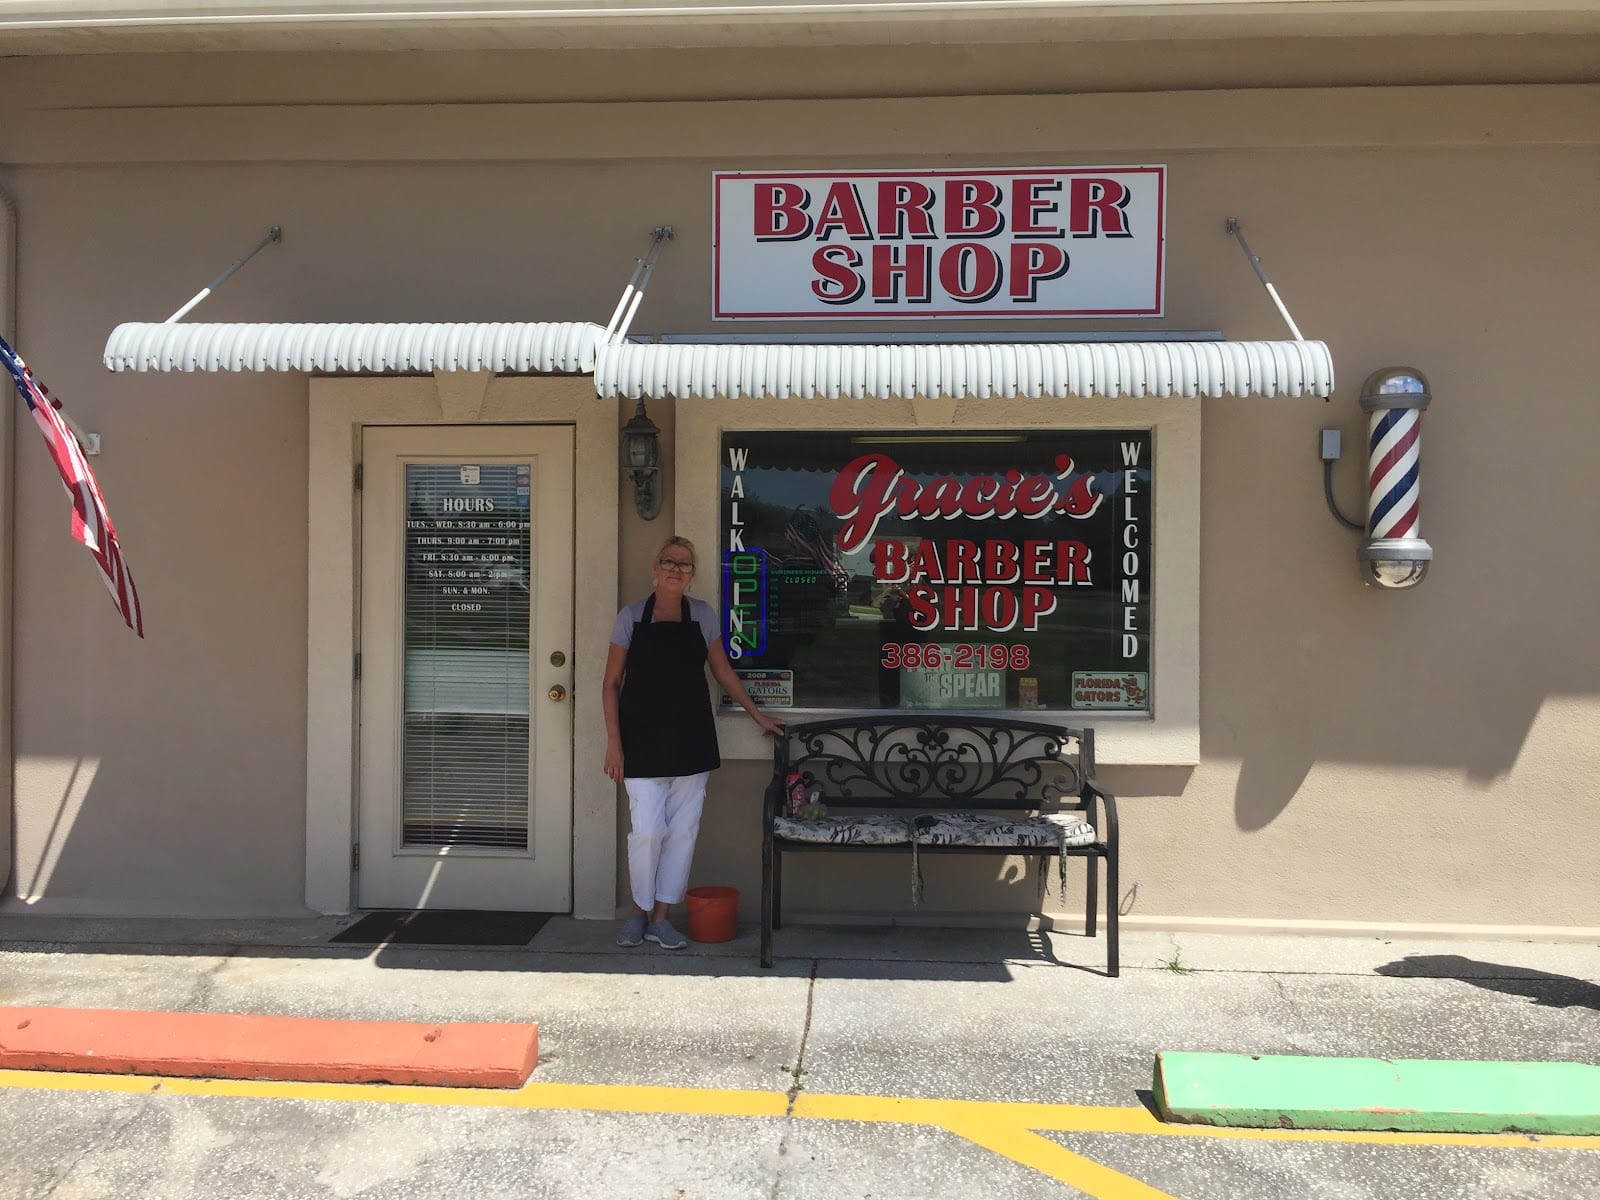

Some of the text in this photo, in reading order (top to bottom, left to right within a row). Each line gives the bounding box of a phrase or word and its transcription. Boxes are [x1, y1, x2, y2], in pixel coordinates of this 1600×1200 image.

[753, 178, 1134, 243] BARBER
[810, 242, 1070, 305] SHOP
[443, 498, 495, 512] HOURS
[829, 453, 1103, 556] Gracie's
[407, 520, 428, 528] TUES.
[435, 520, 455, 529] WED.
[458, 520, 476, 528] 8:30
[498, 520, 517, 528] 6:00
[518, 522, 531, 530] pm
[417, 537, 445, 545] THURS.
[447, 537, 466, 545] 9:00
[487, 537, 506, 545] 7:00
[728, 447, 749, 660] WALK INS
[1120, 441, 1142, 658] WELCOMED
[422, 553, 439, 561] FRI.
[440, 553, 459, 561] 8:30
[481, 553, 500, 561] 6:00
[873, 539, 1094, 586] BARBER
[428, 570, 446, 578] SAT.
[448, 570, 467, 578] 8:00
[784, 576, 817, 584] CLOSED
[442, 586, 460, 594] SUN.
[470, 586, 491, 594] MON.
[451, 603, 482, 611] CLOSED
[733, 555, 758, 649] OPEN
[908, 586, 1058, 632] SHOP
[881, 643, 1031, 671] 386-2198
[940, 672, 1001, 698] SPEAR
[1074, 677, 1121, 689] FLORIDA
[748, 686, 788, 695] GATORS
[1074, 690, 1121, 702] GATORS
